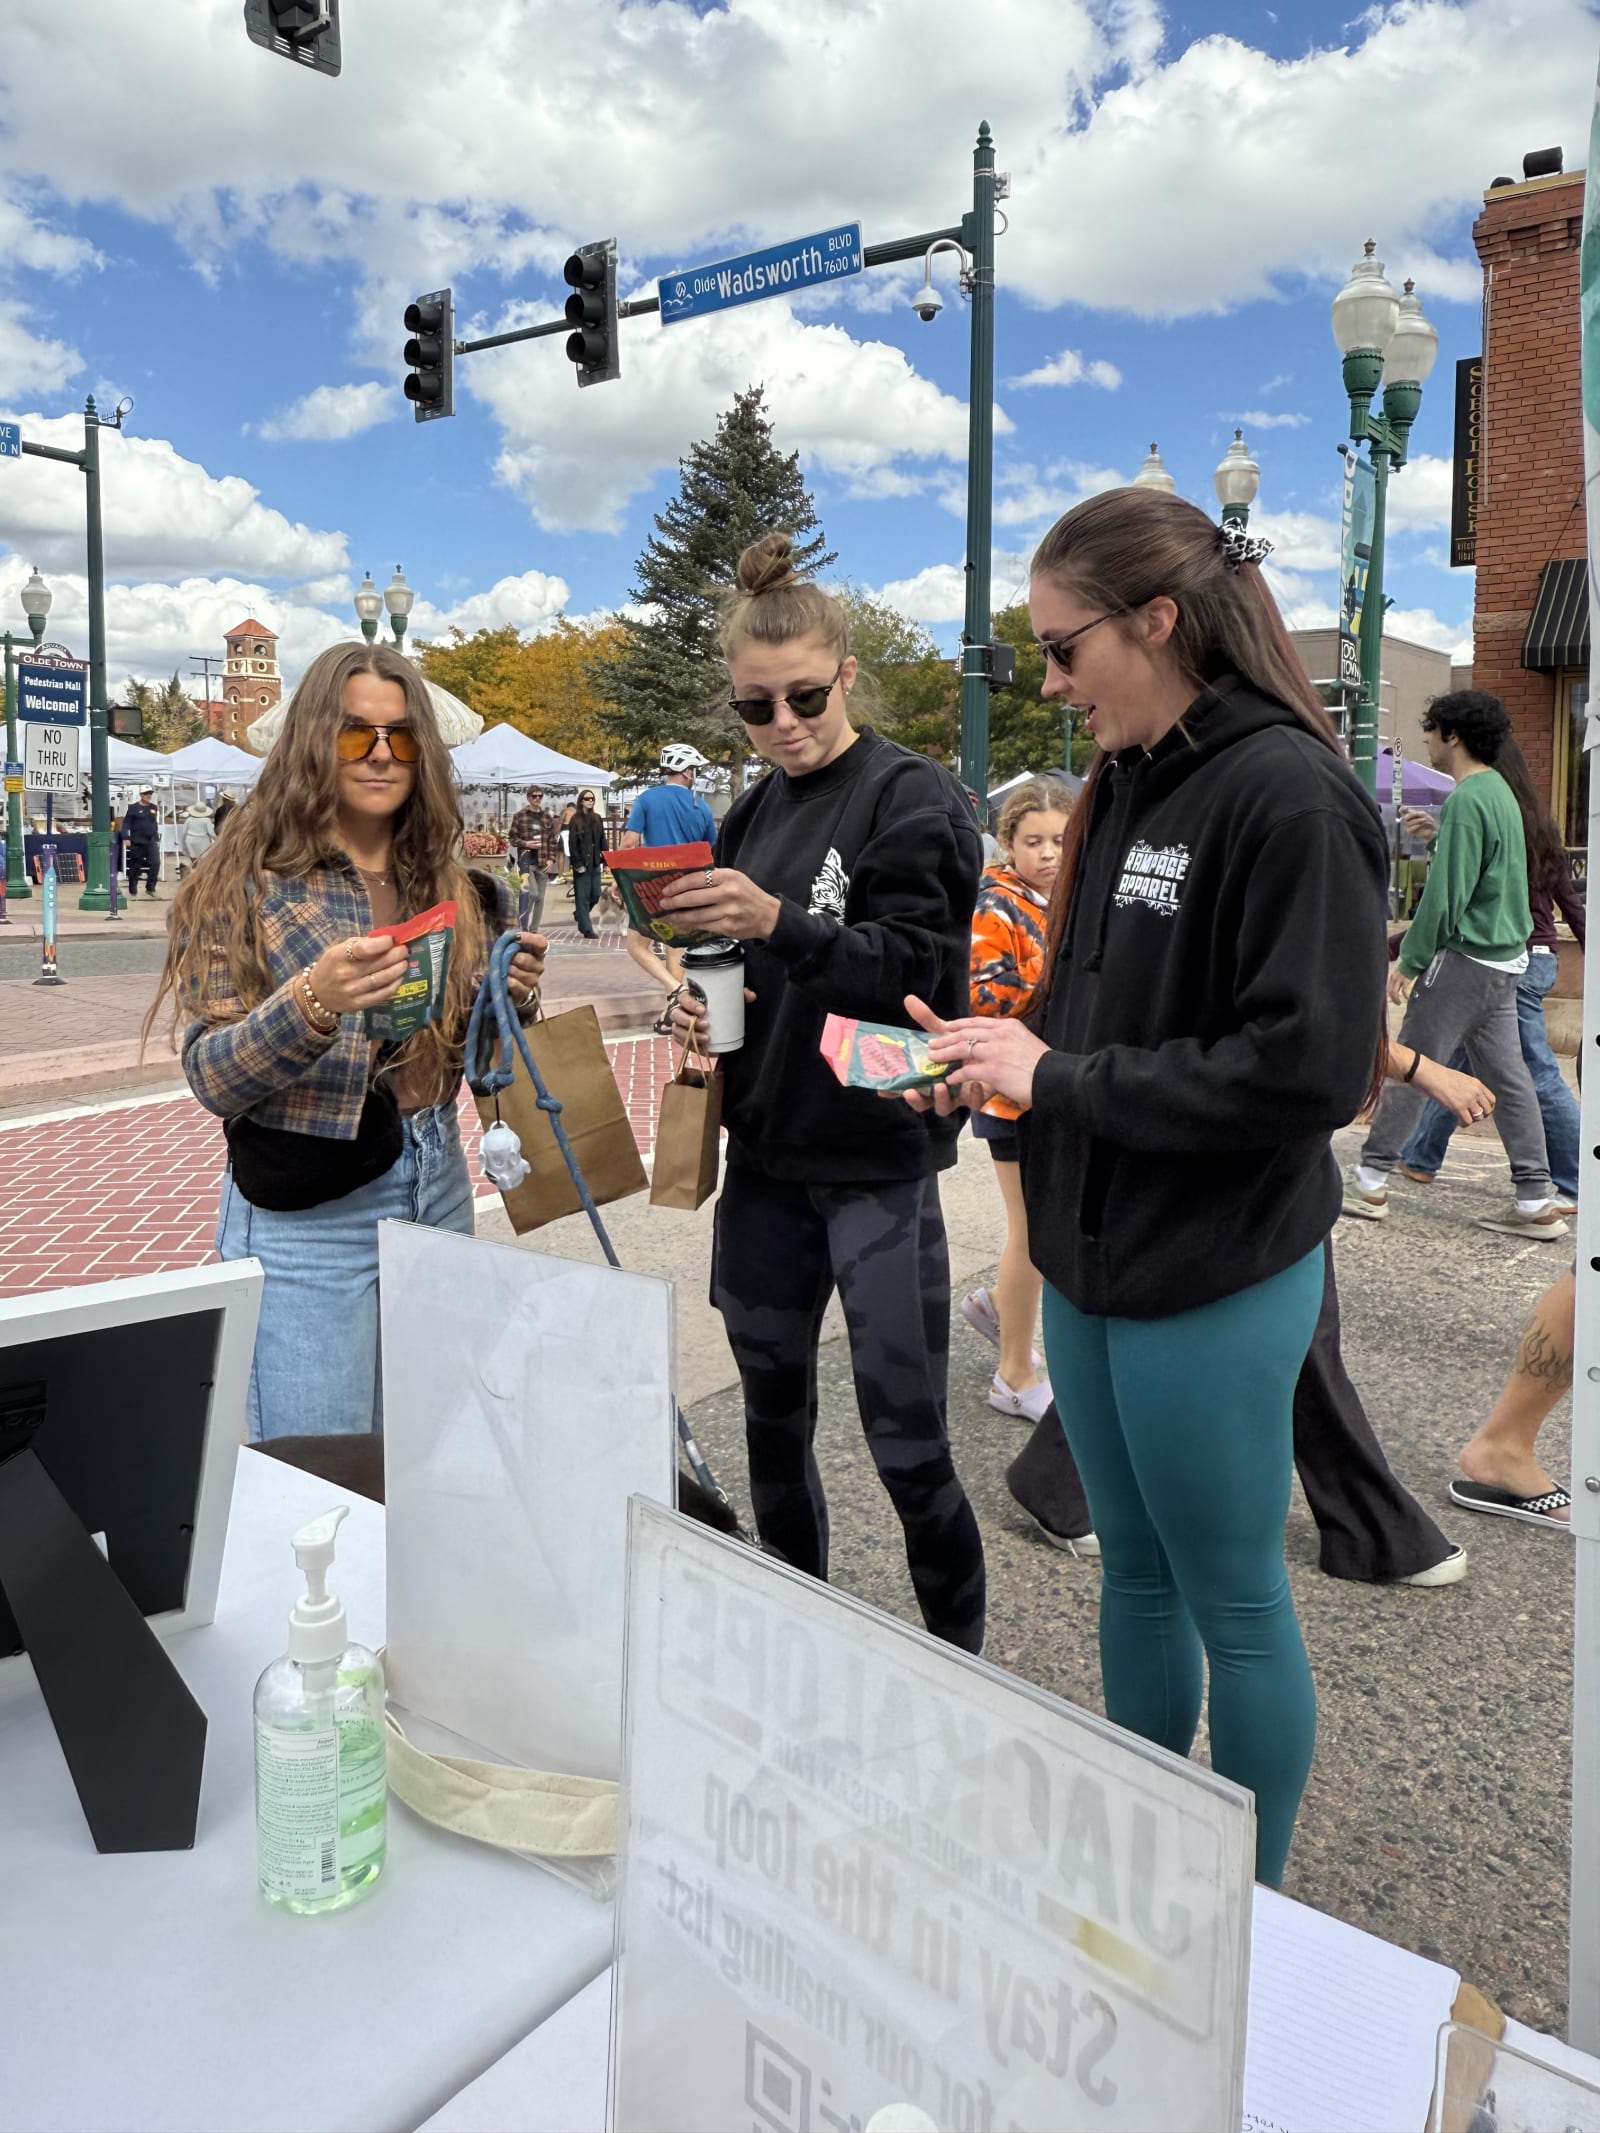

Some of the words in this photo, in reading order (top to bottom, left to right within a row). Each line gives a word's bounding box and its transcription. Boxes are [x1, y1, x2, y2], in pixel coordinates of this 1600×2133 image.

[828, 233, 852, 251] BLVD
[694, 277, 716, 295] Olde
[717, 246, 823, 299] Wadsworth
[824, 256, 849, 275] 7600
[852, 252, 860, 268] W
[11, 443, 18, 455] N
[53, 658, 84, 670] TOWN
[24, 675, 63, 689] Pedestrian
[65, 680, 81, 691] Mall
[25, 695, 79, 713] Welcome!
[44, 729, 62, 744] NO
[37, 750, 66, 766] THRU
[28, 770, 74, 788] TRAFFIC
[1124, 851, 1190, 880] RAMPAGE
[1118, 873, 1180, 903] APPAREL
